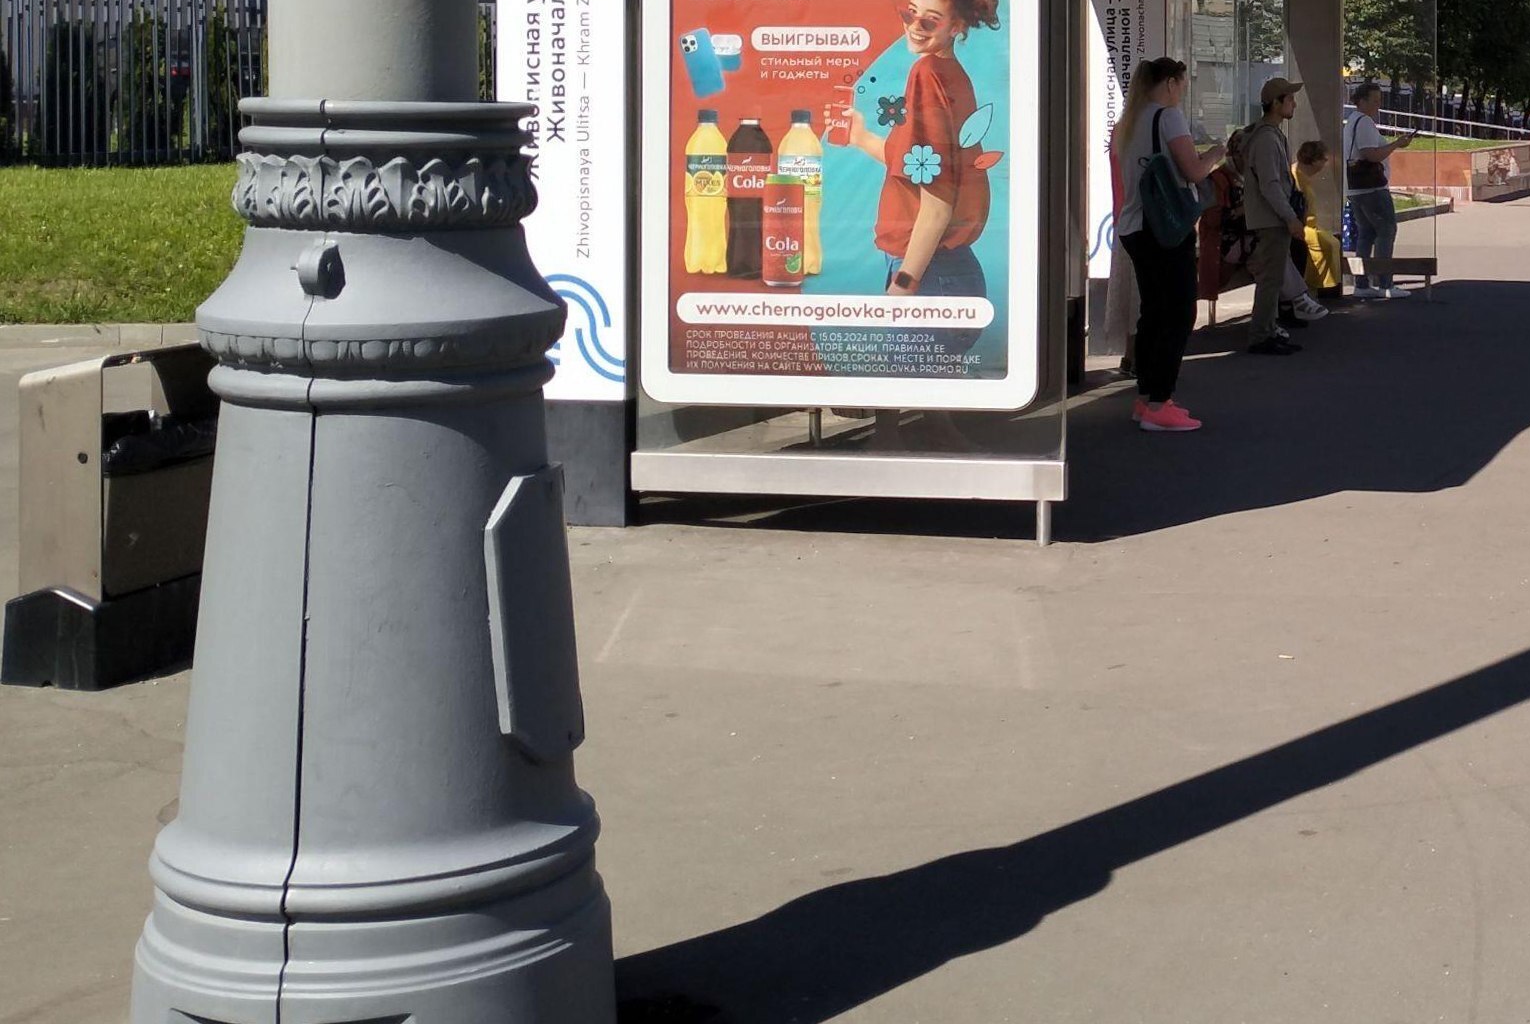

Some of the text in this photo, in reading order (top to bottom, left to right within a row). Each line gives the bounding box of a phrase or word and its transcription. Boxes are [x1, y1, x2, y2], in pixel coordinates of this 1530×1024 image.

[1106, 8, 1118, 53] улица
[577, 12, 590, 65] Khram
[761, 30, 861, 46] ВЫИГРЫВАЙ
[760, 55, 860, 68] стильный мерч
[760, 70, 829, 80] и гаджеты
[577, 96, 590, 142] Ulitsa
[733, 175, 765, 189] Cola
[577, 148, 592, 259] Zhivopisnaya
[765, 236, 799, 251] Cola
[696, 301, 976, 322] www.chernogolovka-promo.ru
[686, 330, 711, 339] СРОК
[714, 330, 775, 341] ПРОВЕДЕНИЯ
[777, 332, 808, 341] АКЦИИ
[810, 332, 816, 341] С
[819, 333, 867, 342] 15.05.2024
[870, 333, 883, 342] ПО
[686, 340, 756, 350] ПОДРОБНОСТИ
[759, 341, 771, 349] ОБ
[774, 341, 843, 351] ОРГАНИЗАТОРЕ
[882, 344, 932, 353] ПРАВИЛАХ
[934, 345, 945, 353] ЕЕ
[752, 351, 810, 361] КОЛИЧЕСТВЕ
[894, 354, 924, 362] МЕСТЕ
[927, 354, 934, 363] И
[936, 354, 981, 364] ПОРЯДКЕ
[686, 360, 698, 369] ИХ
[701, 360, 755, 369] ПОЛУЧЕНИЯ
[758, 361, 770, 370] НА
[773, 361, 801, 371] САЙТЕ
